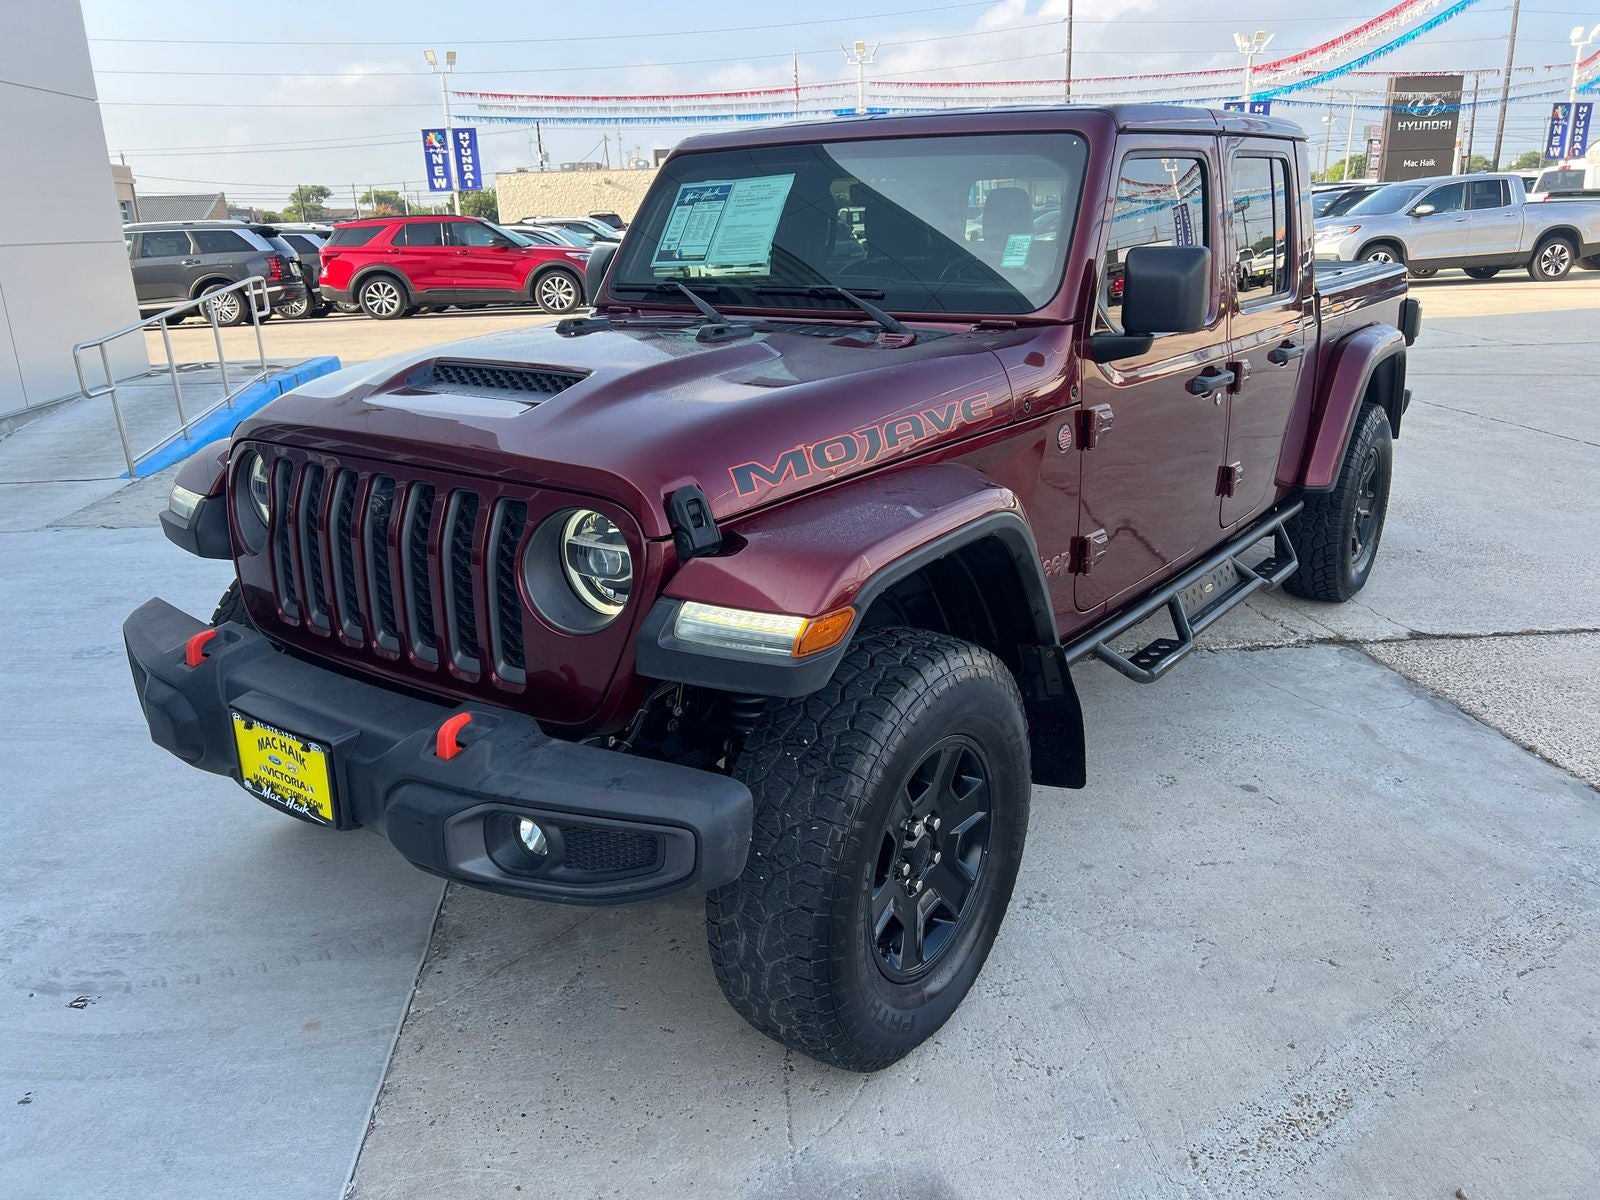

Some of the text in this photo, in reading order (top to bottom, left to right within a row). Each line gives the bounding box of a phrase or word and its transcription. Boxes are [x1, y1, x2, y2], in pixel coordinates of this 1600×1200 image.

[1397, 120, 1452, 131] HYUNDAI
[1549, 124, 1562, 157] NEW
[1573, 105, 1588, 156] HYUNDAI
[431, 153, 447, 188] NEW
[459, 132, 475, 187] HYUNDAI
[1403, 159, 1436, 168] Mac Haik
[728, 391, 993, 498] MOJAVE
[1041, 551, 1072, 577] eep
[257, 736, 279, 752] MAC
[279, 740, 307, 771] HAIK
[266, 765, 308, 792] VICTORIA
[261, 784, 312, 814] Mac Haik
